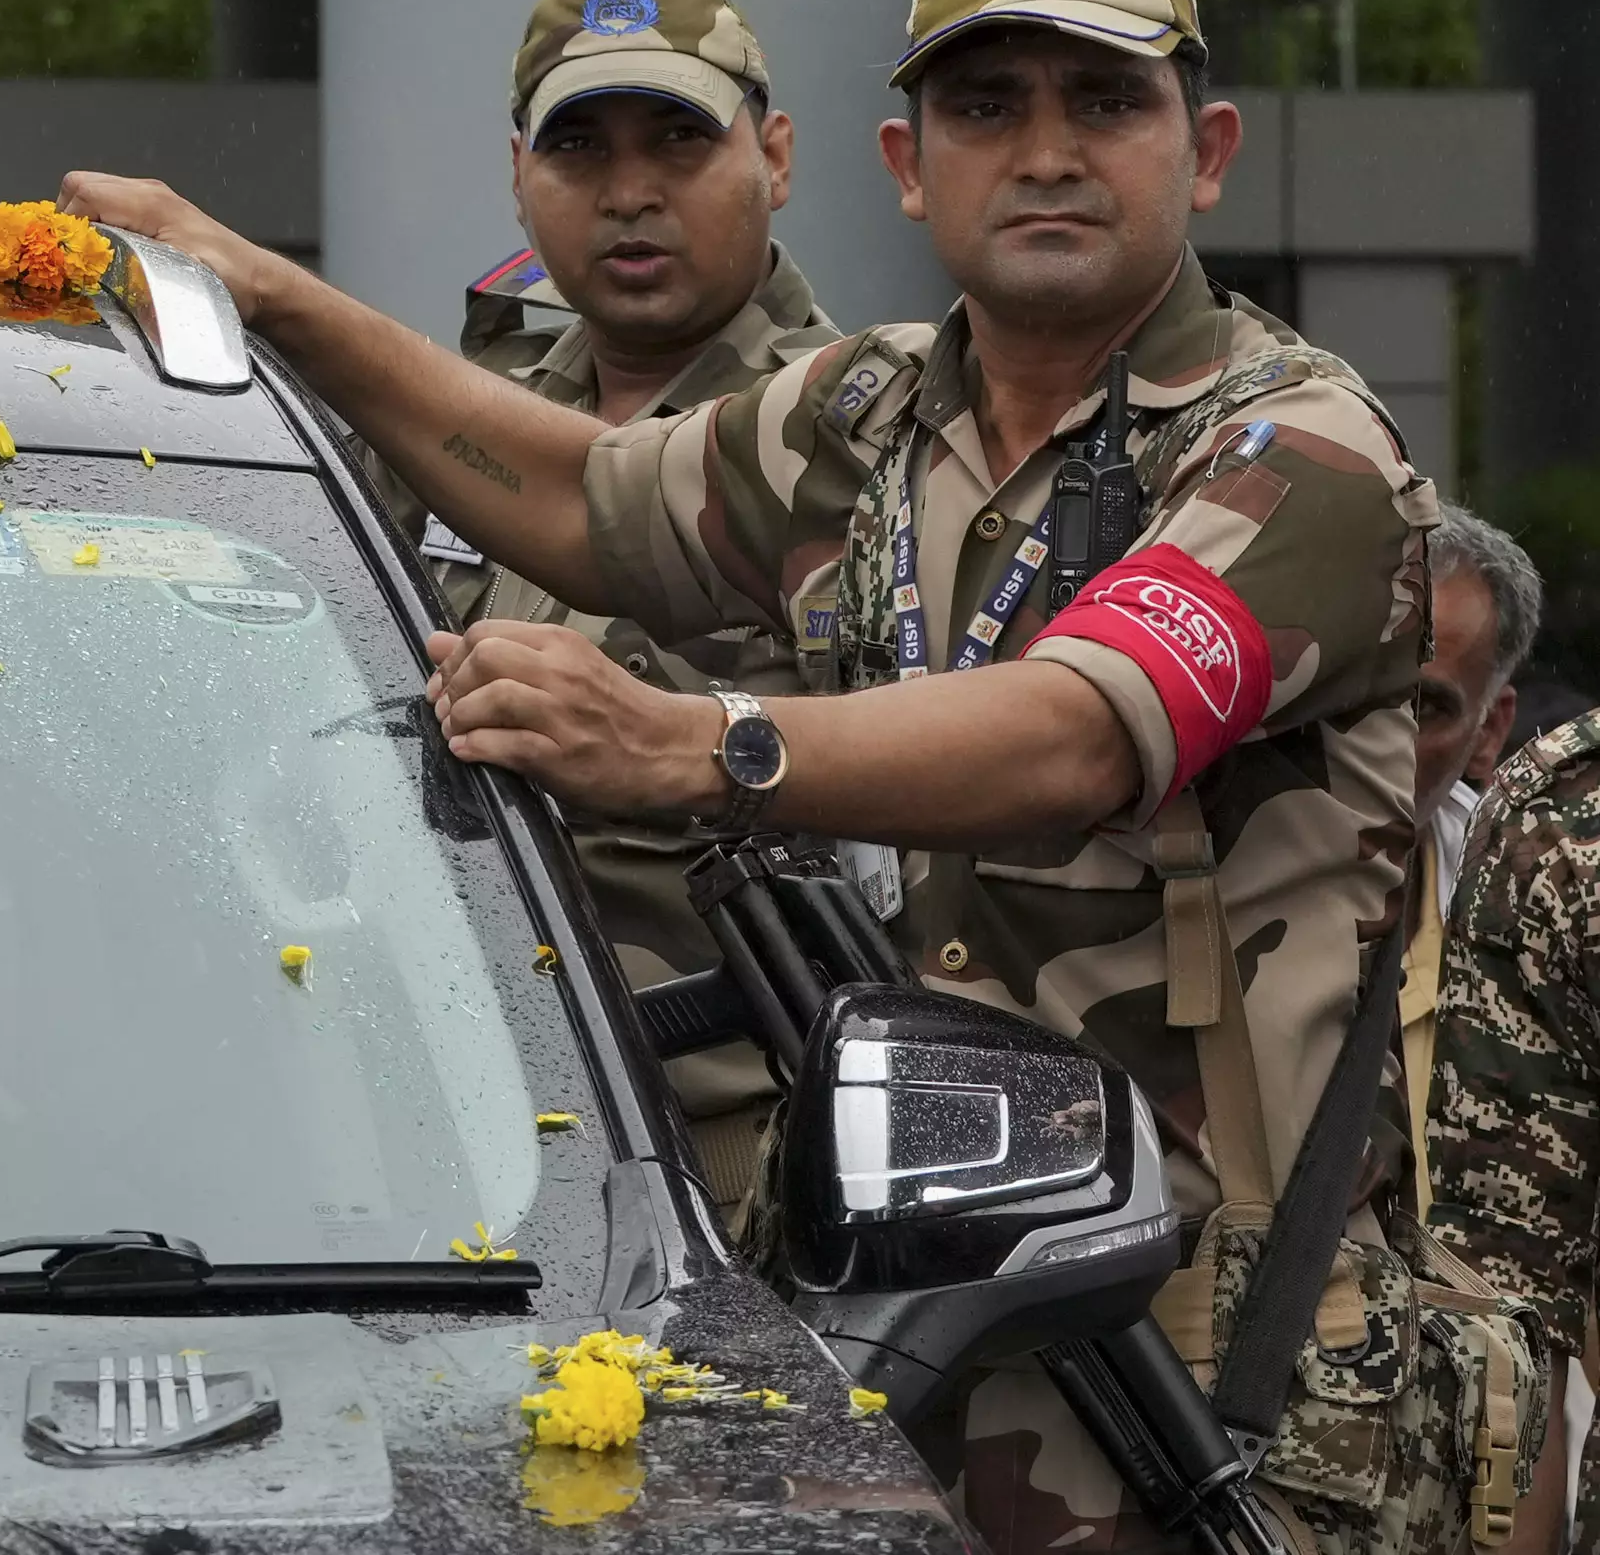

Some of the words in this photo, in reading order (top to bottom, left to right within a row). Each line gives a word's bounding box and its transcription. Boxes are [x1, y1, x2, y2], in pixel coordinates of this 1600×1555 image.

[599, 4, 641, 22] CISF
[897, 535, 909, 578] CISF
[211, 588, 278, 604] G-013
[993, 568, 1026, 613] CISF
[903, 618, 920, 661] CISF
[1138, 584, 1233, 669] CISF
[953, 644, 978, 674] SF
